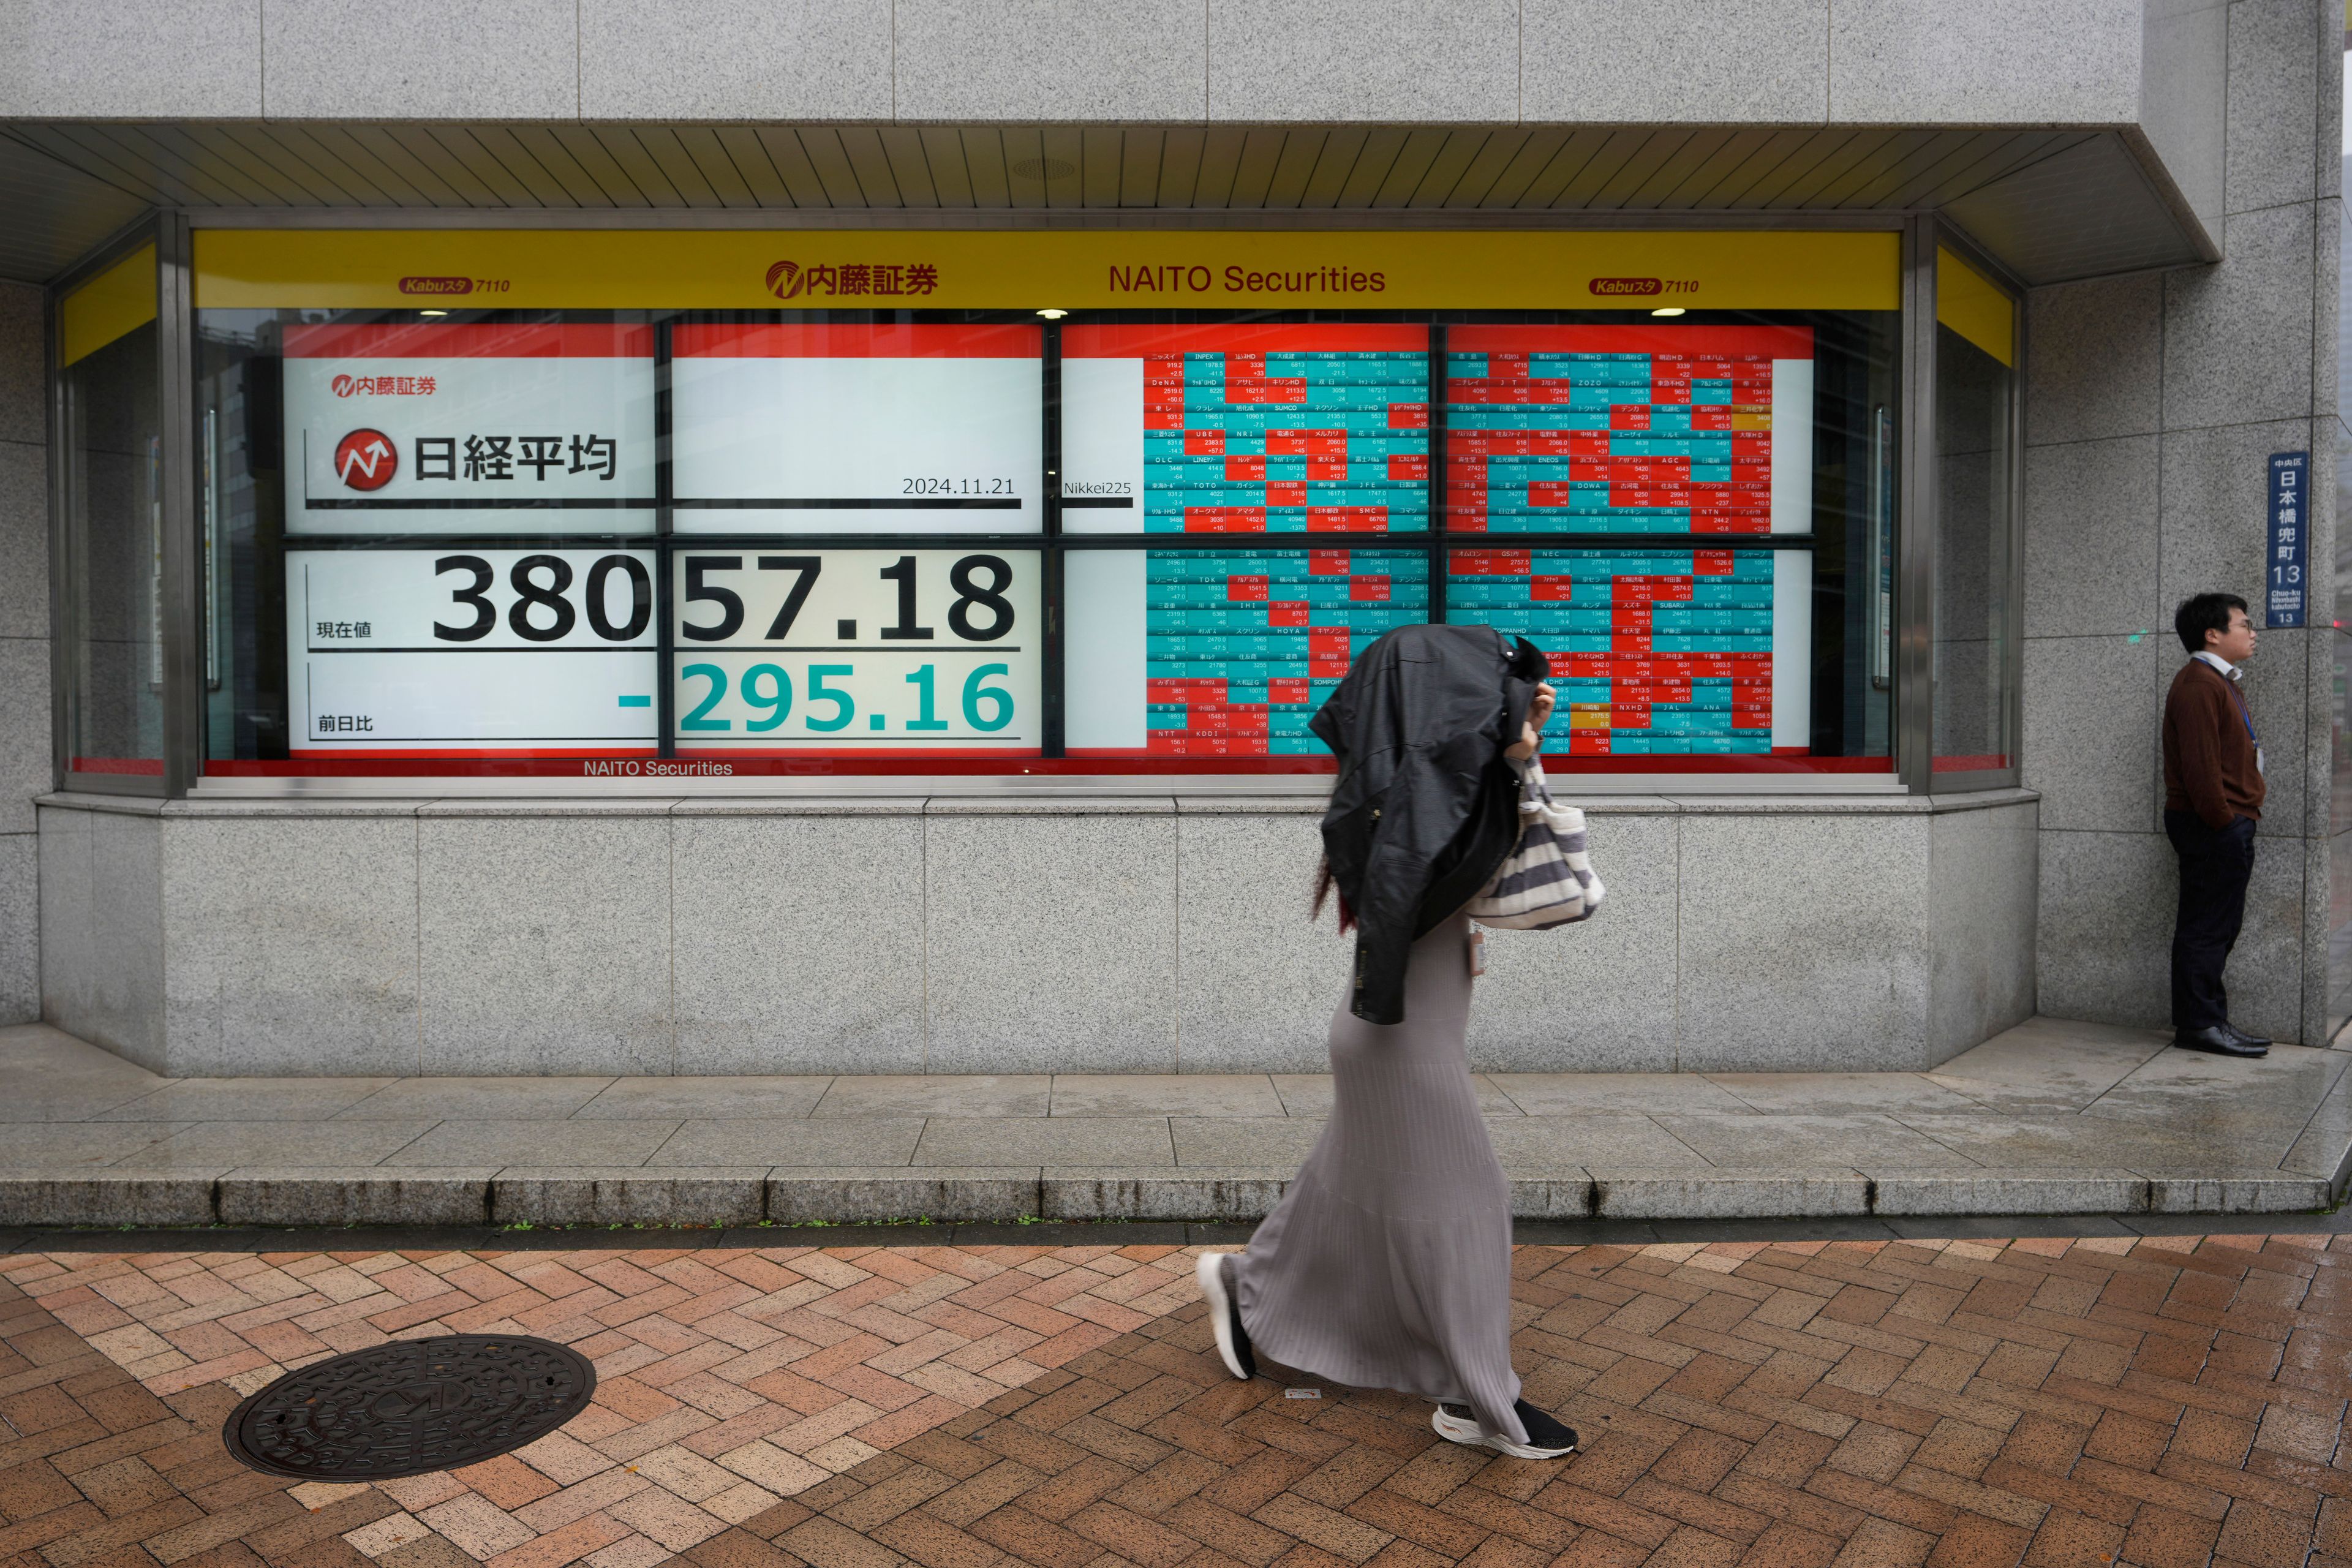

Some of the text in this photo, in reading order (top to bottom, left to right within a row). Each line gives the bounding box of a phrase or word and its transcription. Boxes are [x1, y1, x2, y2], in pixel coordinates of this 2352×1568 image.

[405, 278, 511, 293] Kabuスタ 7110
[807, 263, 938, 296] 内藤証券
[1110, 265, 1385, 292] NAITO Securities
[1596, 280, 1700, 293] Kabuスタ 7110
[356, 376, 437, 396] 内藤証券
[415, 434, 617, 481] 日経平均
[2275, 458, 2302, 467] 中央区
[903, 478, 1014, 494] 2024.11.21
[1065, 481, 1131, 494] Nikkei225
[2278, 470, 2297, 560] 日本橋兜町
[2274, 565, 2300, 583] 13
[2279, 613, 2293, 623] 13
[316, 622, 372, 638] 現在値
[318, 715, 373, 732] 前日比
[584, 761, 733, 775] NAITO Securities
